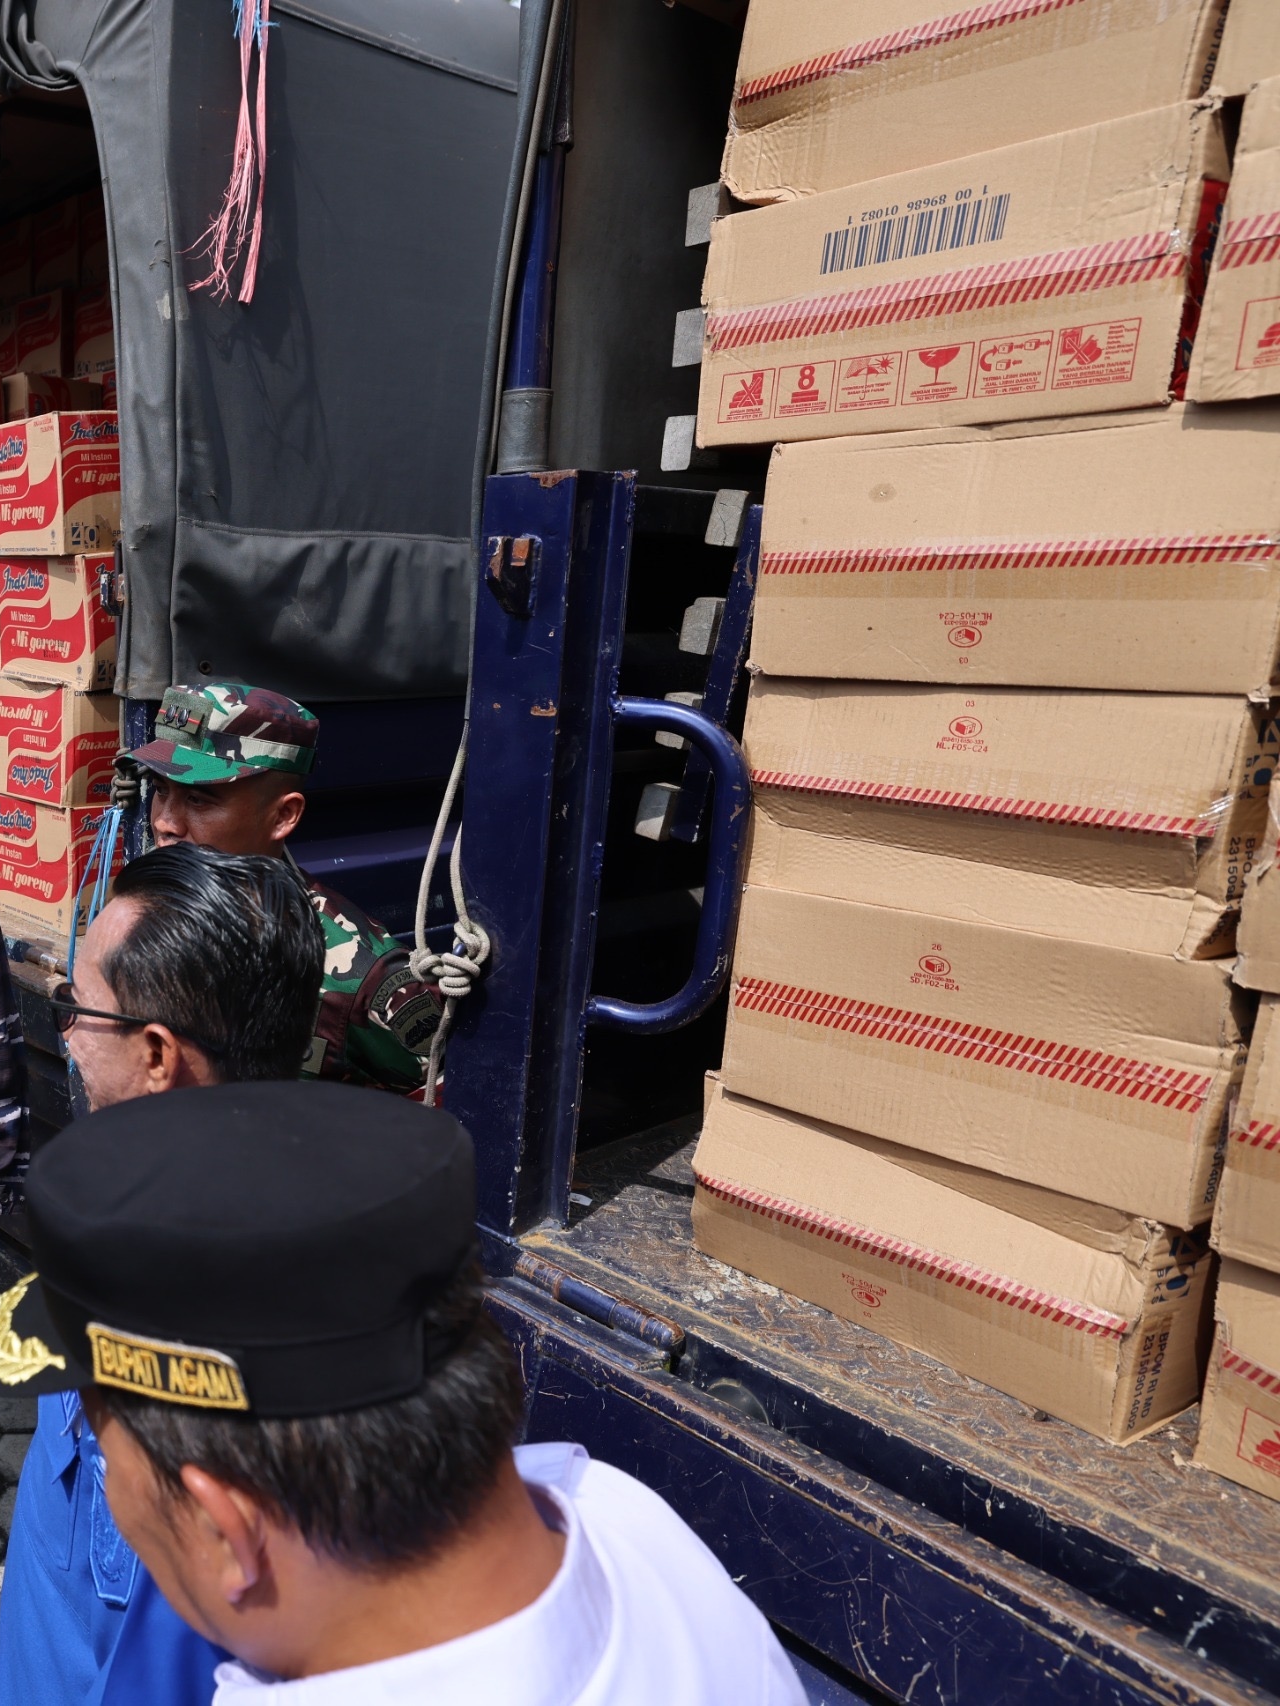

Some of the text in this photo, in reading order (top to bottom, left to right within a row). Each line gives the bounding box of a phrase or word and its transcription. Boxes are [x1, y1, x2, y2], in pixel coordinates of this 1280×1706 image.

[847, 184, 989, 226] 1 00 89686 01082 1
[798, 365, 815, 390] 8
[80, 452, 113, 462] Mi Instan
[75, 470, 120, 486] Mi gor
[2, 483, 17, 495] Instan
[11, 504, 45, 526] goreng
[10, 610, 36, 623] Mi Instan
[11, 629, 71, 659] Mi goreng
[958, 656, 969, 665] 03
[965, 700, 975, 708] 03
[31, 706, 49, 728] Mi
[22, 733, 47, 748] Mi Instan
[6, 845, 23, 861] Instan
[14, 870, 54, 899] goreng
[931, 943, 942, 952] 26
[372, 970, 413, 1009] KODIM 030
[910, 976, 960, 992] SD.F02-B24
[97, 1336, 237, 1401] BUPATI AGAM
[1140, 1331, 1170, 1420] BPOM RI MD
[1126, 1334, 1155, 1431] 231509014002
